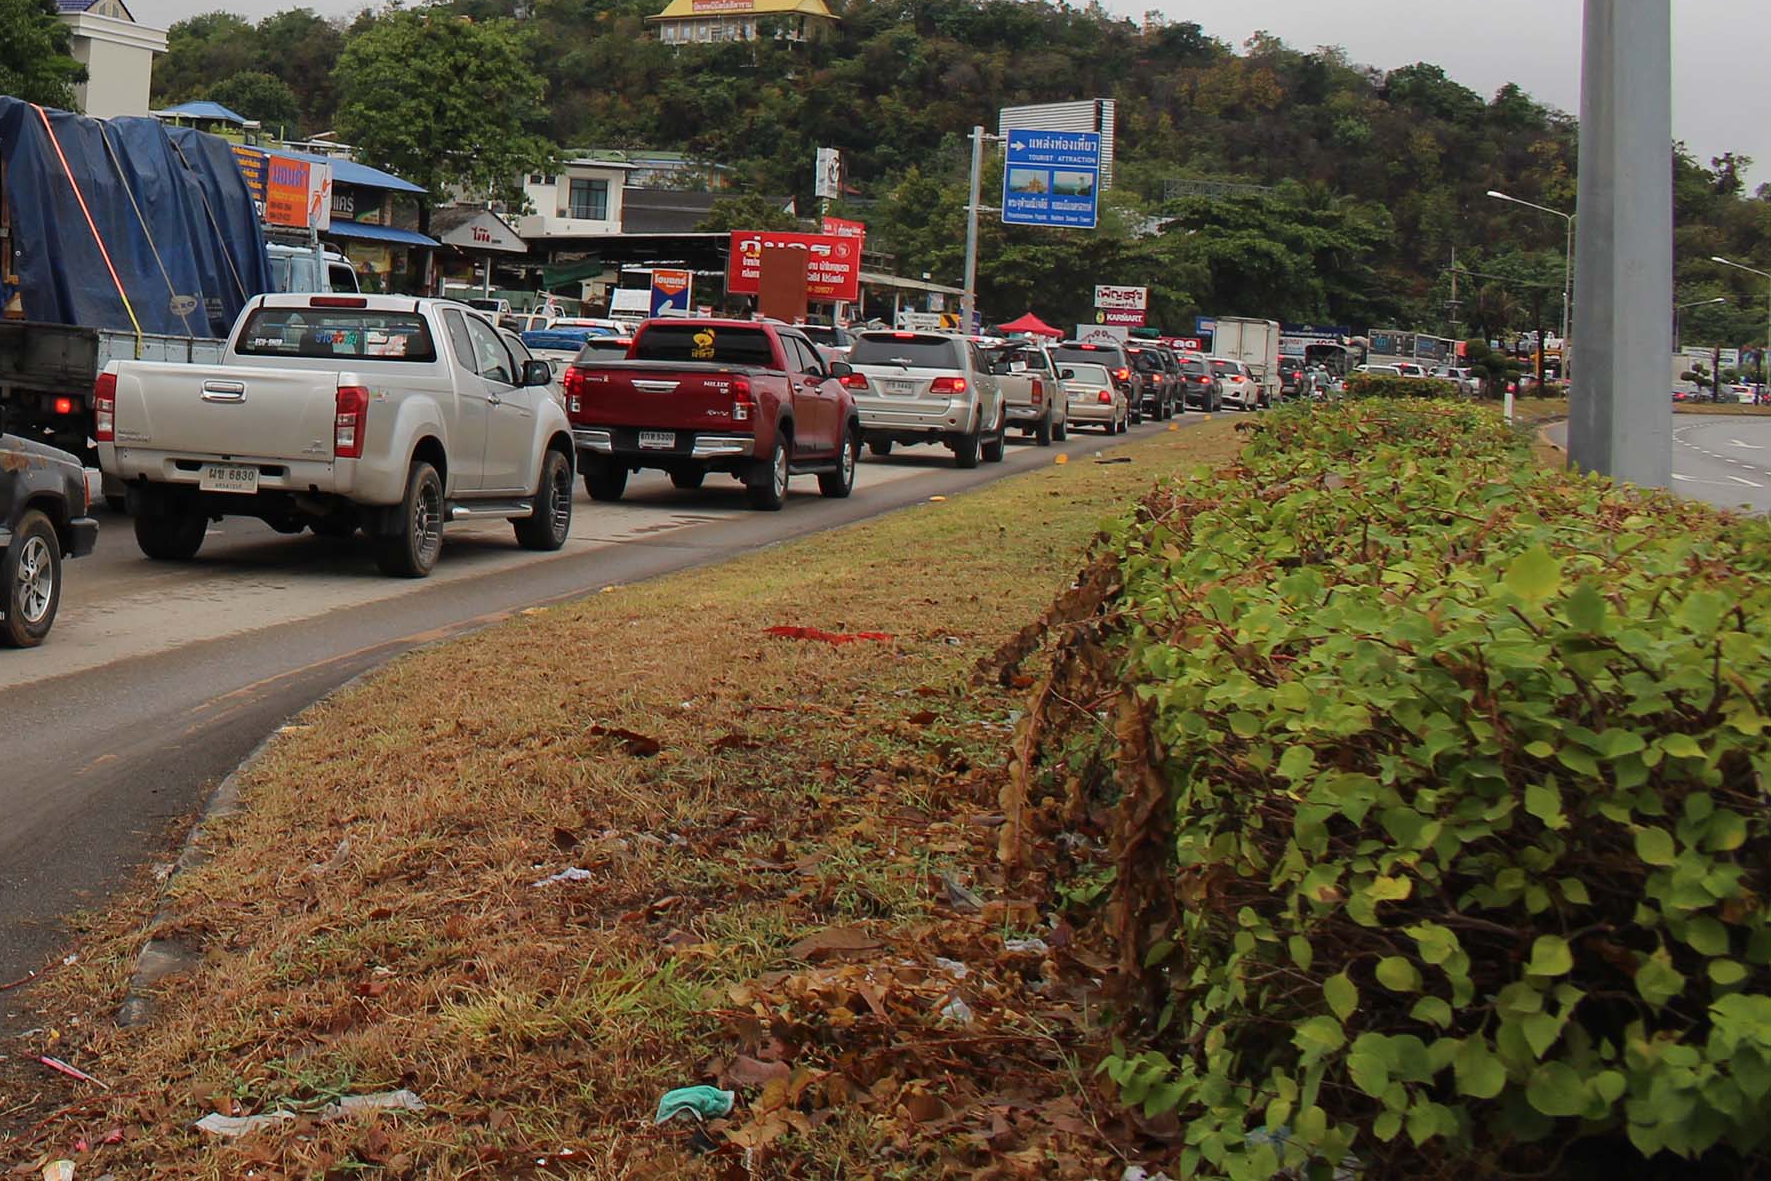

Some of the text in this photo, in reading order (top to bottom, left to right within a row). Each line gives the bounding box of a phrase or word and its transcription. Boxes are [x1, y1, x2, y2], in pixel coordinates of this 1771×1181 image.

[1029, 134, 1096, 151] แหล่งท่องเที่ยว
